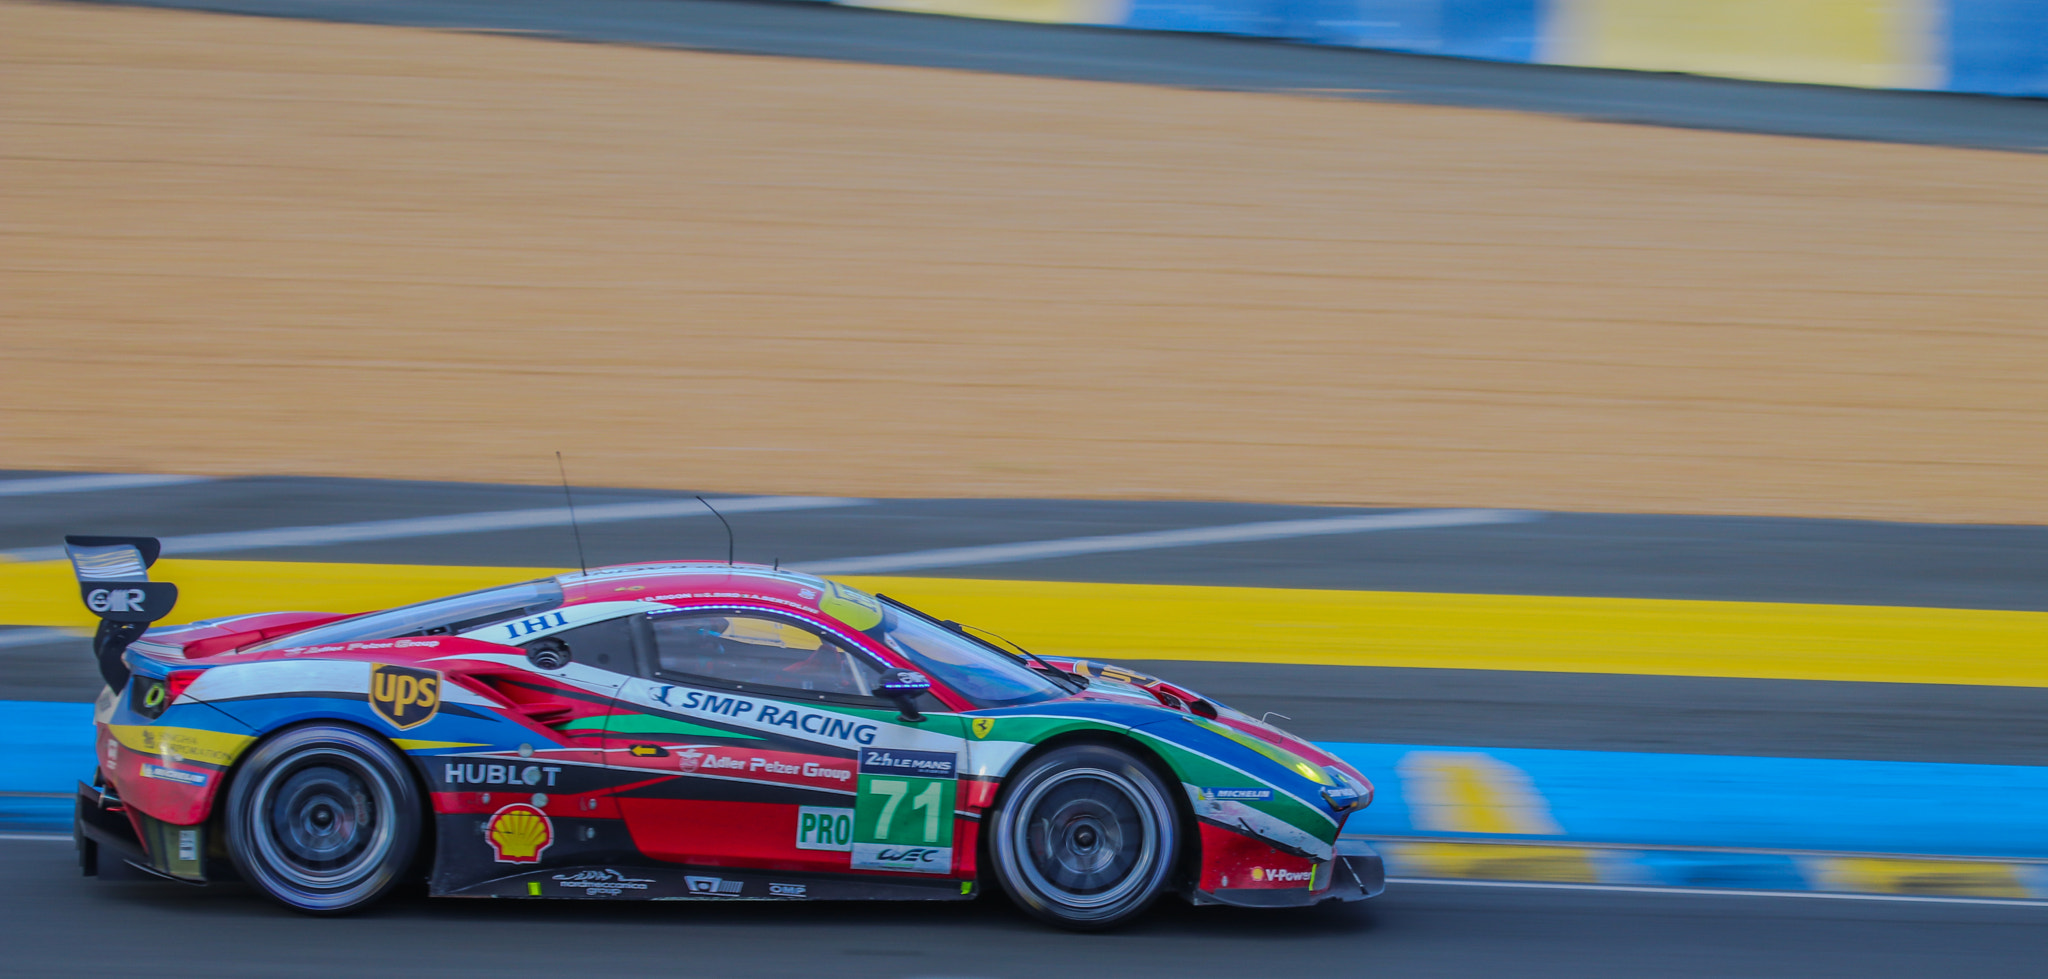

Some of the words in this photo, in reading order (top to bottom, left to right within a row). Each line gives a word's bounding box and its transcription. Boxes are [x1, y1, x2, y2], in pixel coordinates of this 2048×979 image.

[507, 611, 569, 639] IHI
[374, 672, 437, 716] ups
[682, 691, 754, 718] SMP
[756, 705, 878, 746] RACING
[702, 754, 746, 770] Adler
[750, 757, 800, 775] Pelzer
[803, 762, 851, 782] Group
[893, 759, 911, 768] LE
[911, 760, 952, 770] MANS
[1217, 790, 1271, 798] MICHELIN
[869, 779, 942, 843] 71
[800, 813, 850, 845] PRO
[877, 848, 939, 862] WEC
[1266, 869, 1312, 881] V-Power
[586, 887, 622, 896] group
[769, 885, 806, 894] OMP
